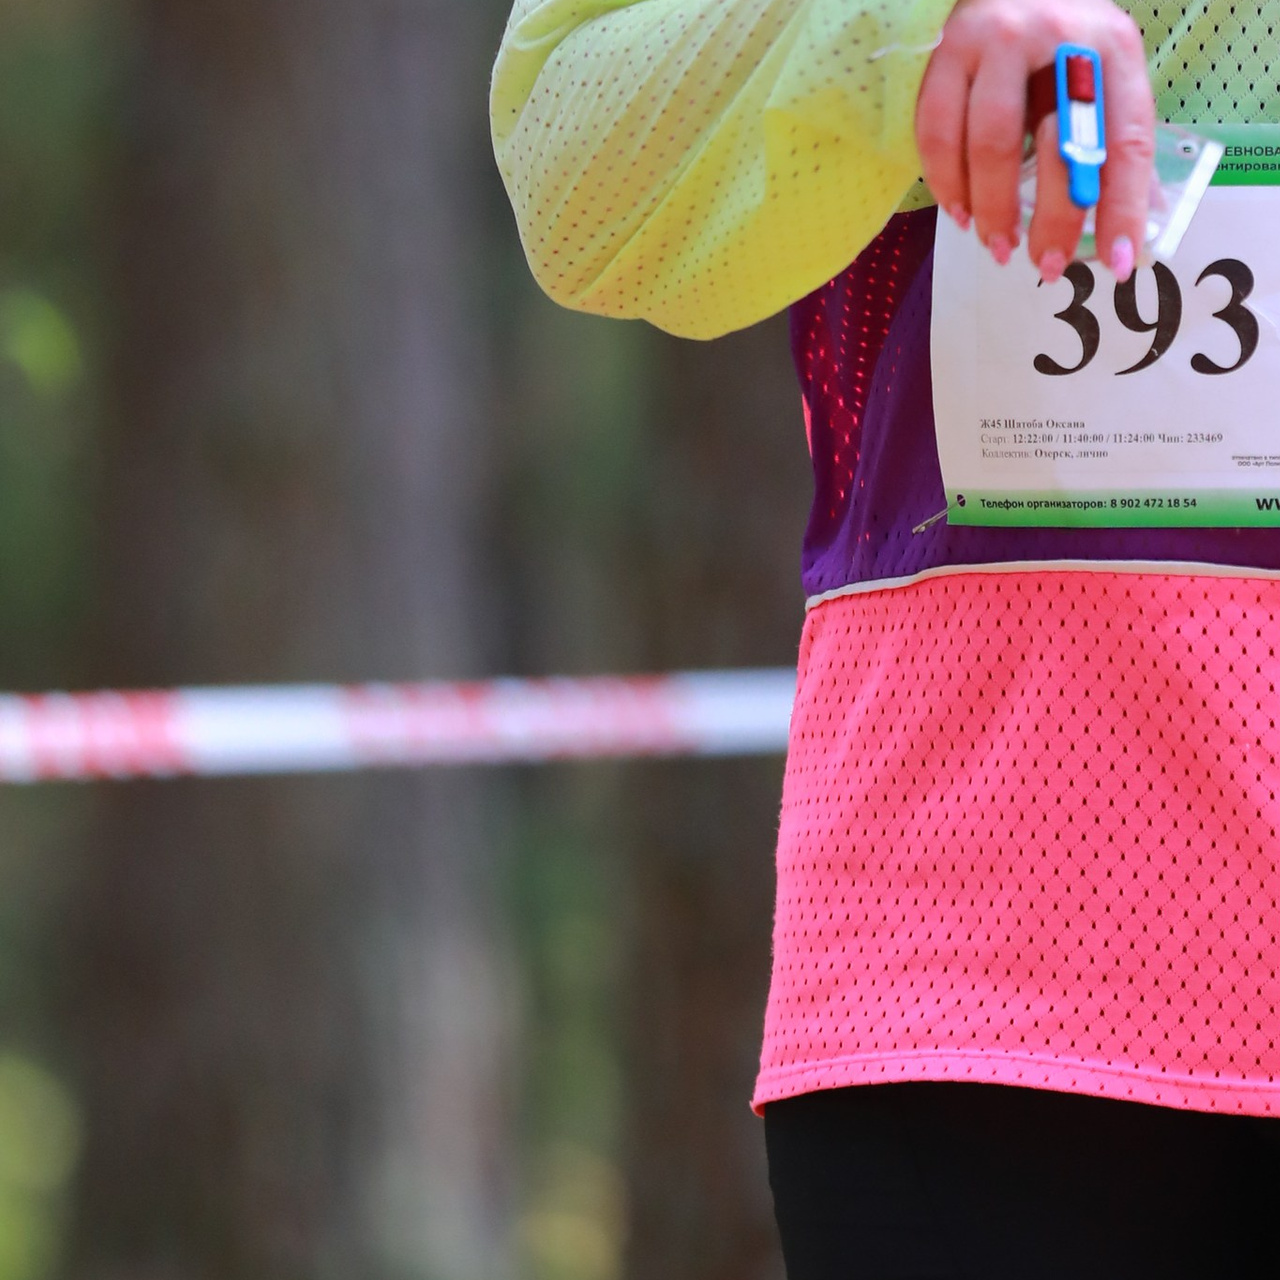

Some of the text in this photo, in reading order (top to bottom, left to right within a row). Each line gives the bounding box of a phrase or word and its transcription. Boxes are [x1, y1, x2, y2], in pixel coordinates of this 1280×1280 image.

[1033, 258, 1260, 376] 393
[980, 419, 1002, 429] Ж45
[1046, 419, 1086, 429] Оксана
[1013, 434, 1053, 444] 12:22:00
[1063, 434, 1104, 444] 11:40:00
[1113, 434, 1155, 444] 11:24:00
[1187, 433, 1223, 444] 233469
[980, 498, 1197, 510] Телефон организаторов: 8 902 472 18 54
